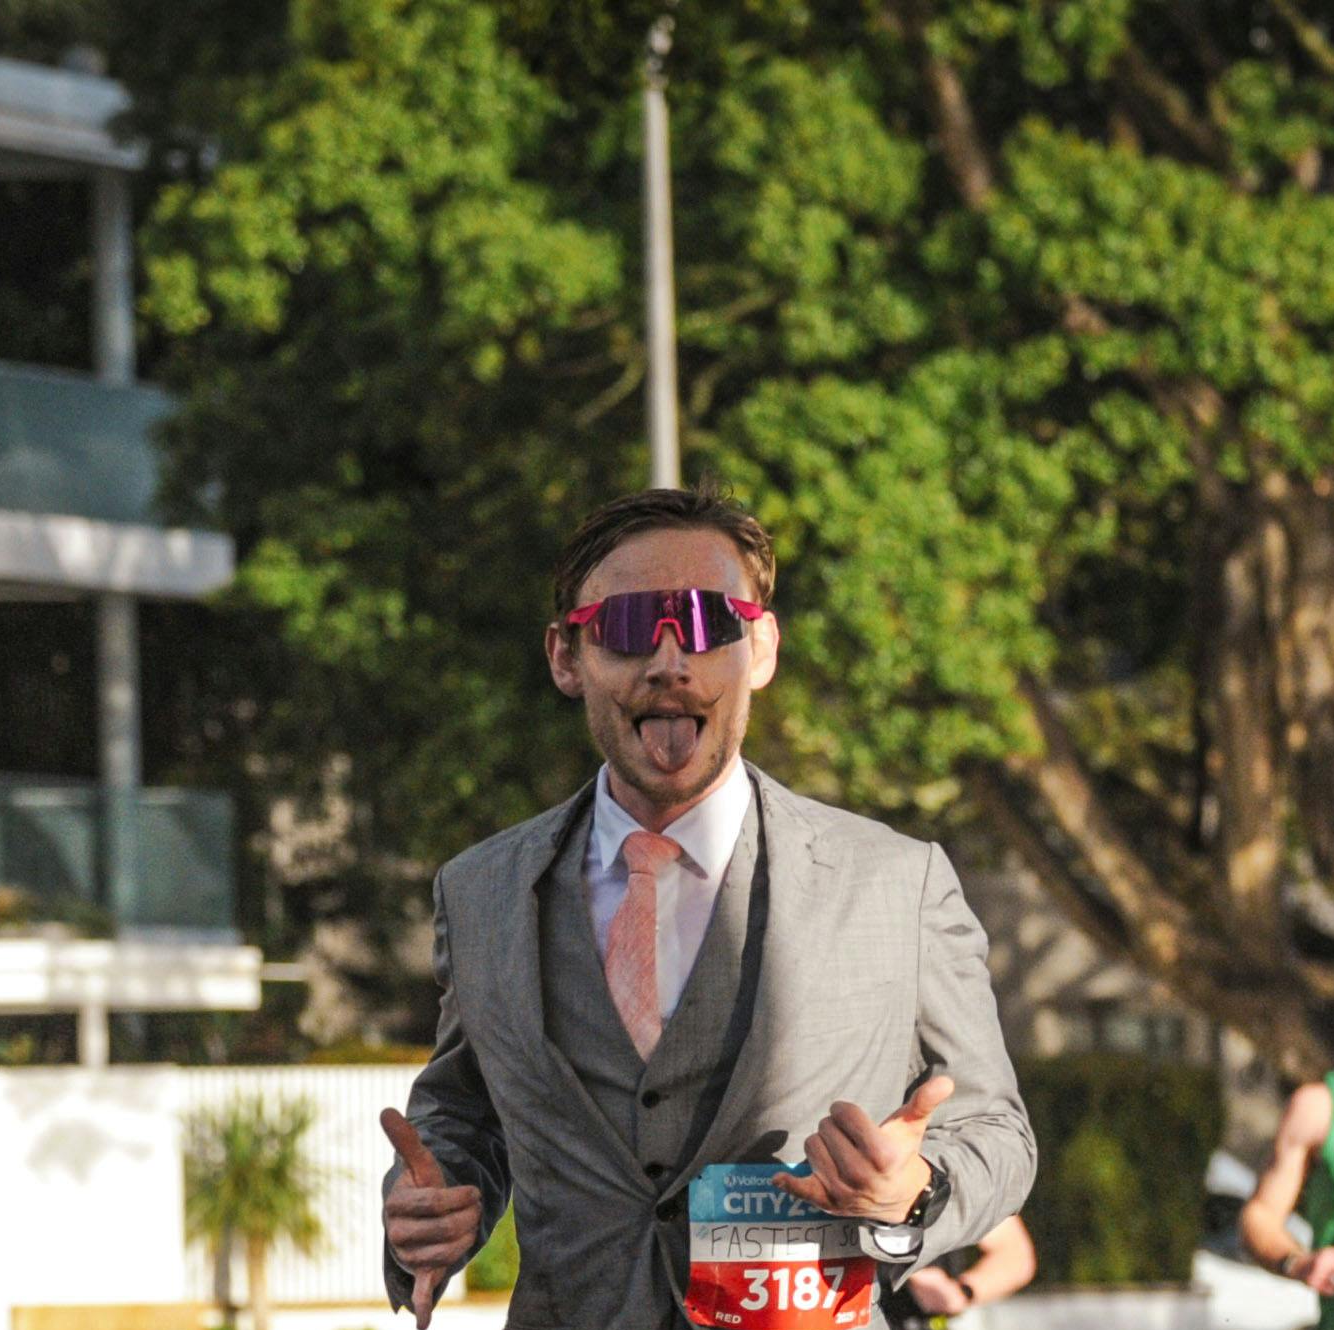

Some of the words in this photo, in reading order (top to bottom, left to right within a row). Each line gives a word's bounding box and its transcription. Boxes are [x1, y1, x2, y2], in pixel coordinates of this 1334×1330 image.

[724, 1191, 817, 1217] CITY2
[710, 1224, 831, 1259] FASTEST
[740, 1267, 844, 1311] 3187
[715, 1311, 742, 1324] RED
